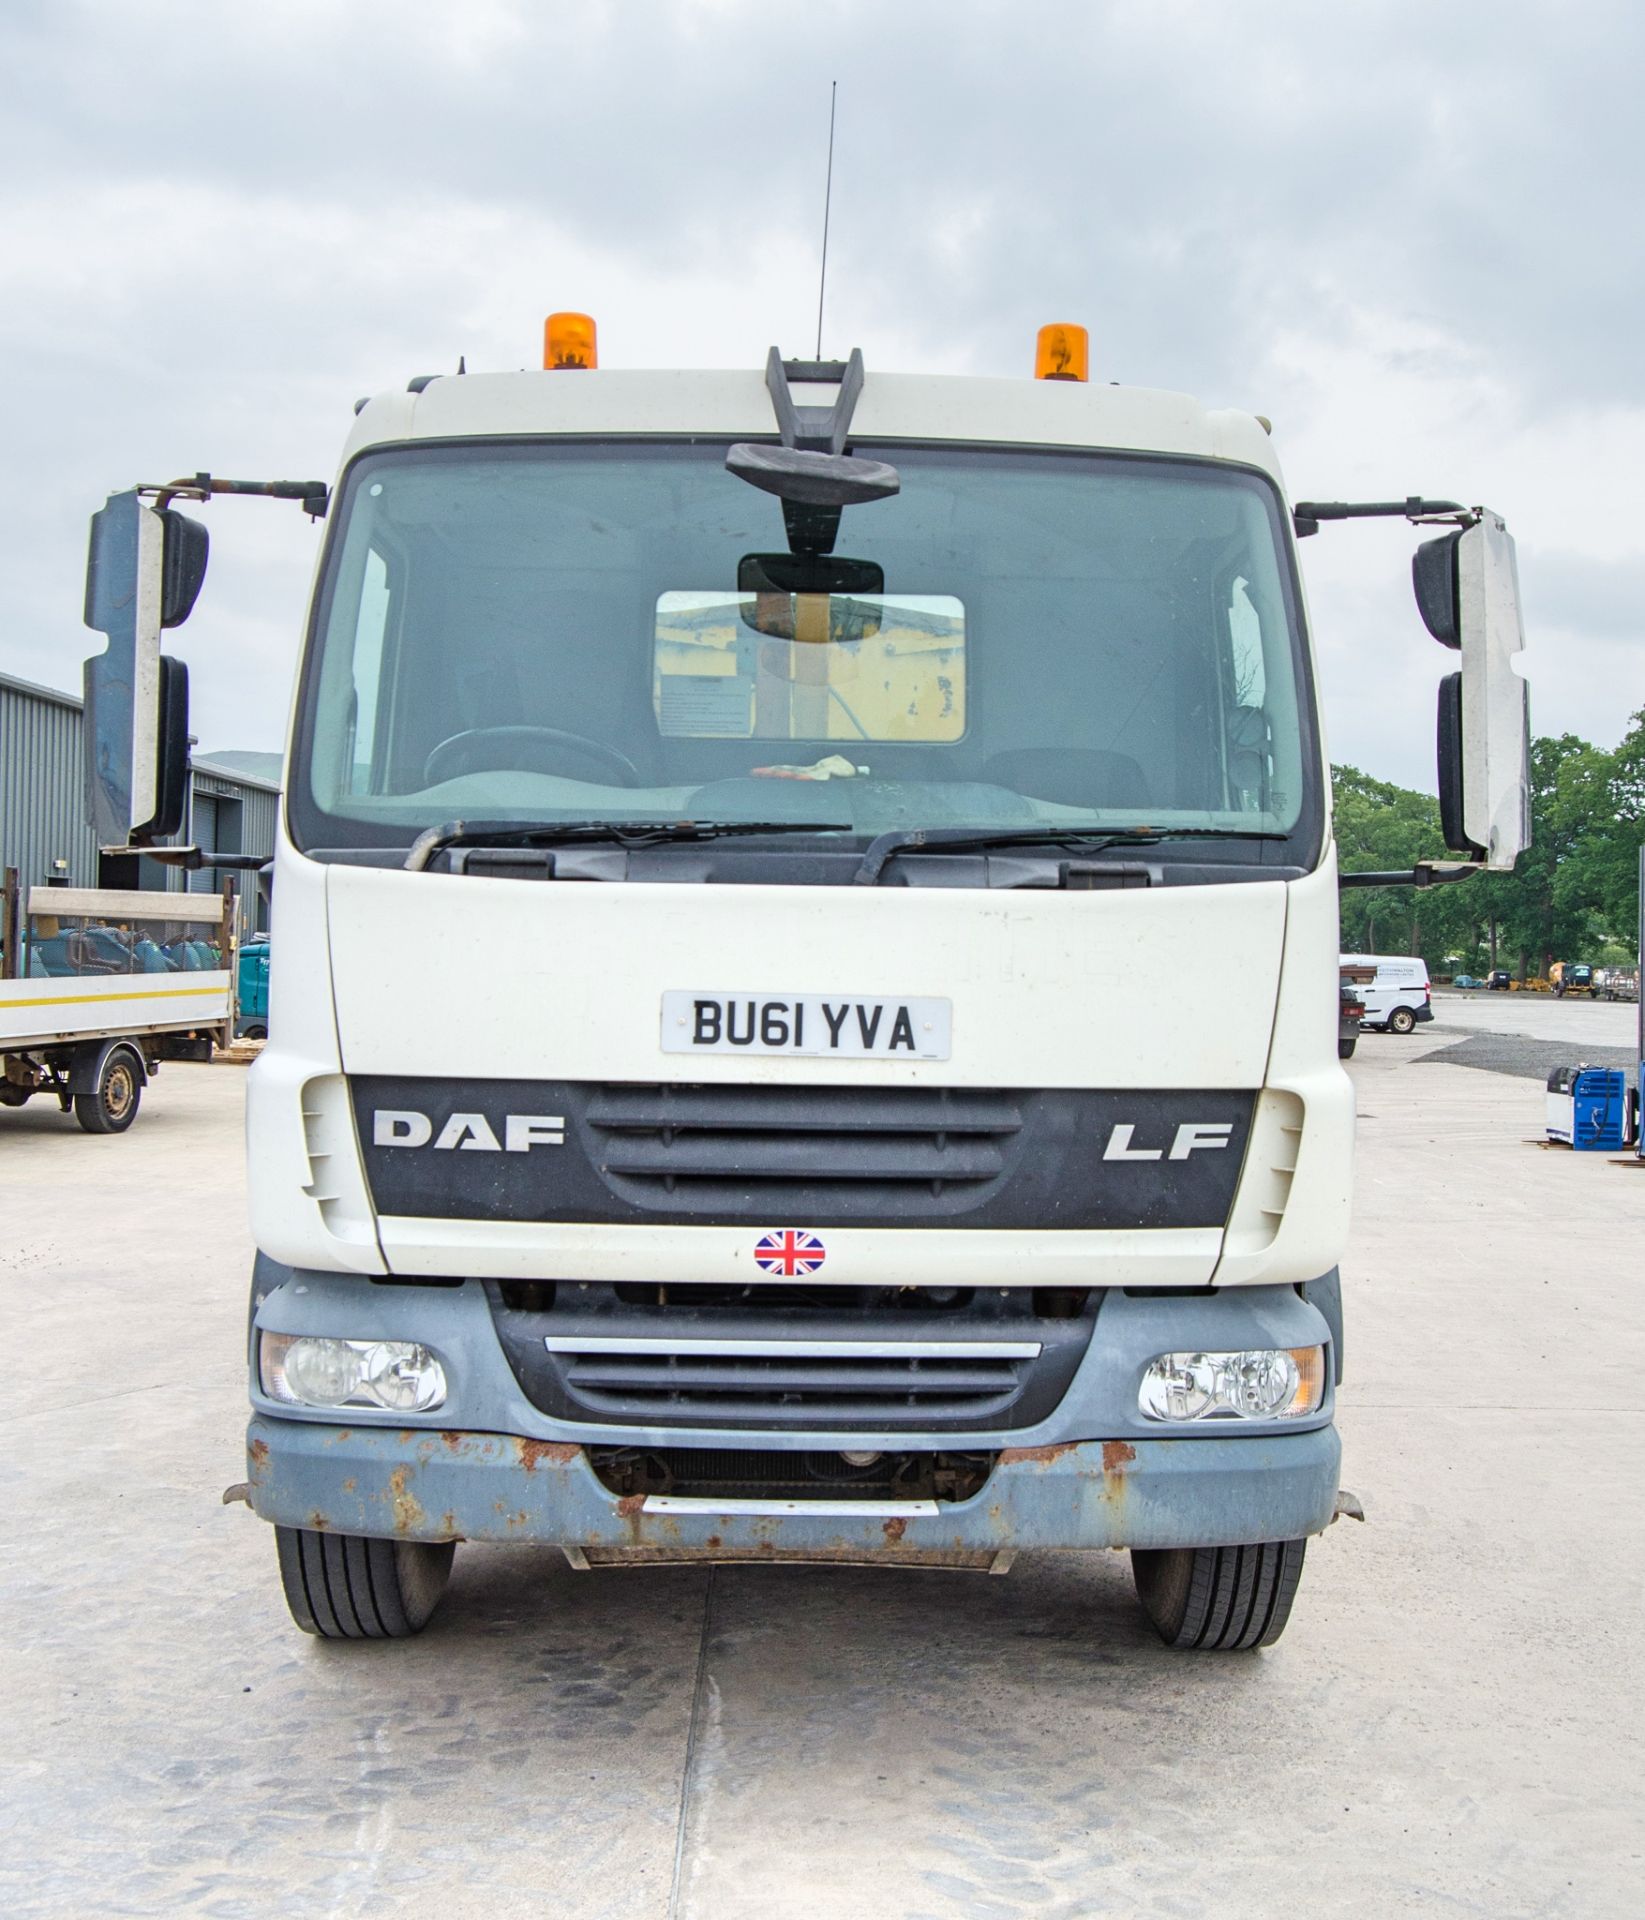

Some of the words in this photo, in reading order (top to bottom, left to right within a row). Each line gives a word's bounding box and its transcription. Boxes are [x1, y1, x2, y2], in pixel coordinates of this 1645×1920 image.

[693, 1000, 803, 1047] BU61
[822, 1003, 916, 1050] YVA
[373, 1110, 565, 1152] DAF
[1102, 1123, 1233, 1160] LF
